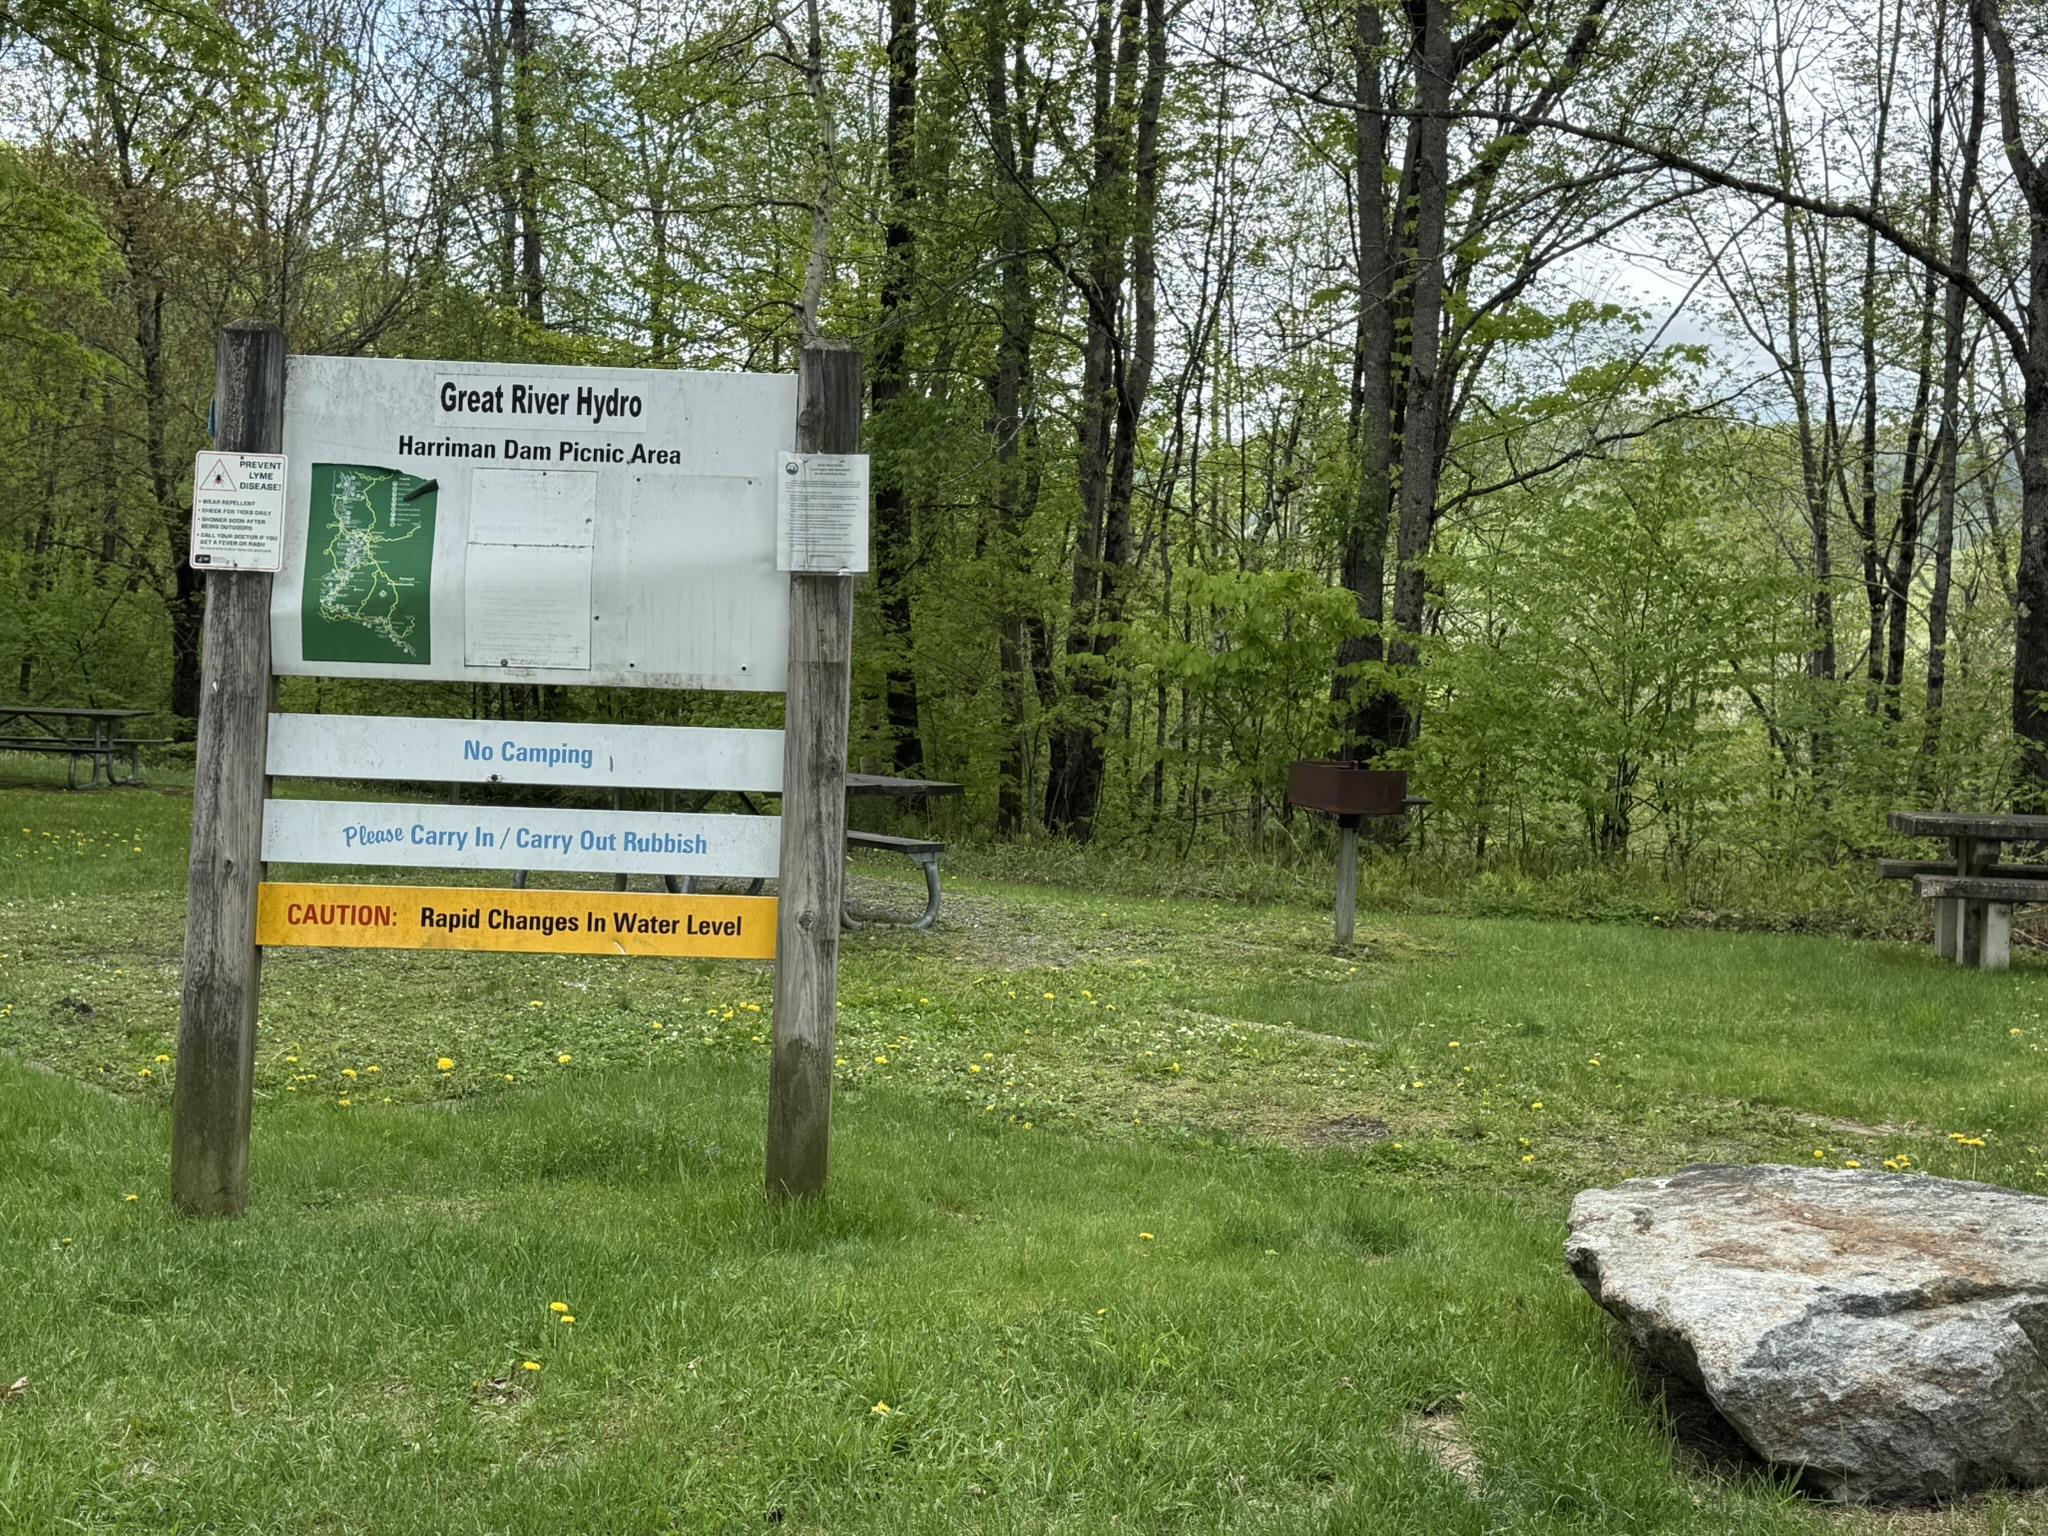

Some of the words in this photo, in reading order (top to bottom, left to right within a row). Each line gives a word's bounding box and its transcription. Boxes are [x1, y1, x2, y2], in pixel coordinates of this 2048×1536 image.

[440, 381, 504, 414] Great
[511, 383, 570, 416] River
[576, 386, 643, 425] Hydro
[240, 460, 282, 470] PREVENT
[398, 434, 496, 460] Harriman
[503, 439, 552, 462] Dam
[559, 441, 625, 464] Picnic
[631, 443, 682, 466] Area
[240, 482, 281, 491] DISEASE!
[249, 471, 274, 480] LYME
[463, 739, 495, 762] No
[500, 740, 593, 769] Camping
[342, 823, 405, 848] Please
[410, 824, 468, 851] Carry
[474, 826, 496, 849] In
[499, 827, 512, 851] /
[515, 827, 574, 855] Carry
[580, 830, 618, 853] Out
[623, 831, 709, 856] Rubbish
[286, 902, 398, 928] CAUTION:
[420, 906, 481, 931] Rapid
[487, 908, 580, 936] Changes
[587, 911, 607, 933] In
[613, 912, 681, 936] Water
[686, 914, 743, 937] Level
